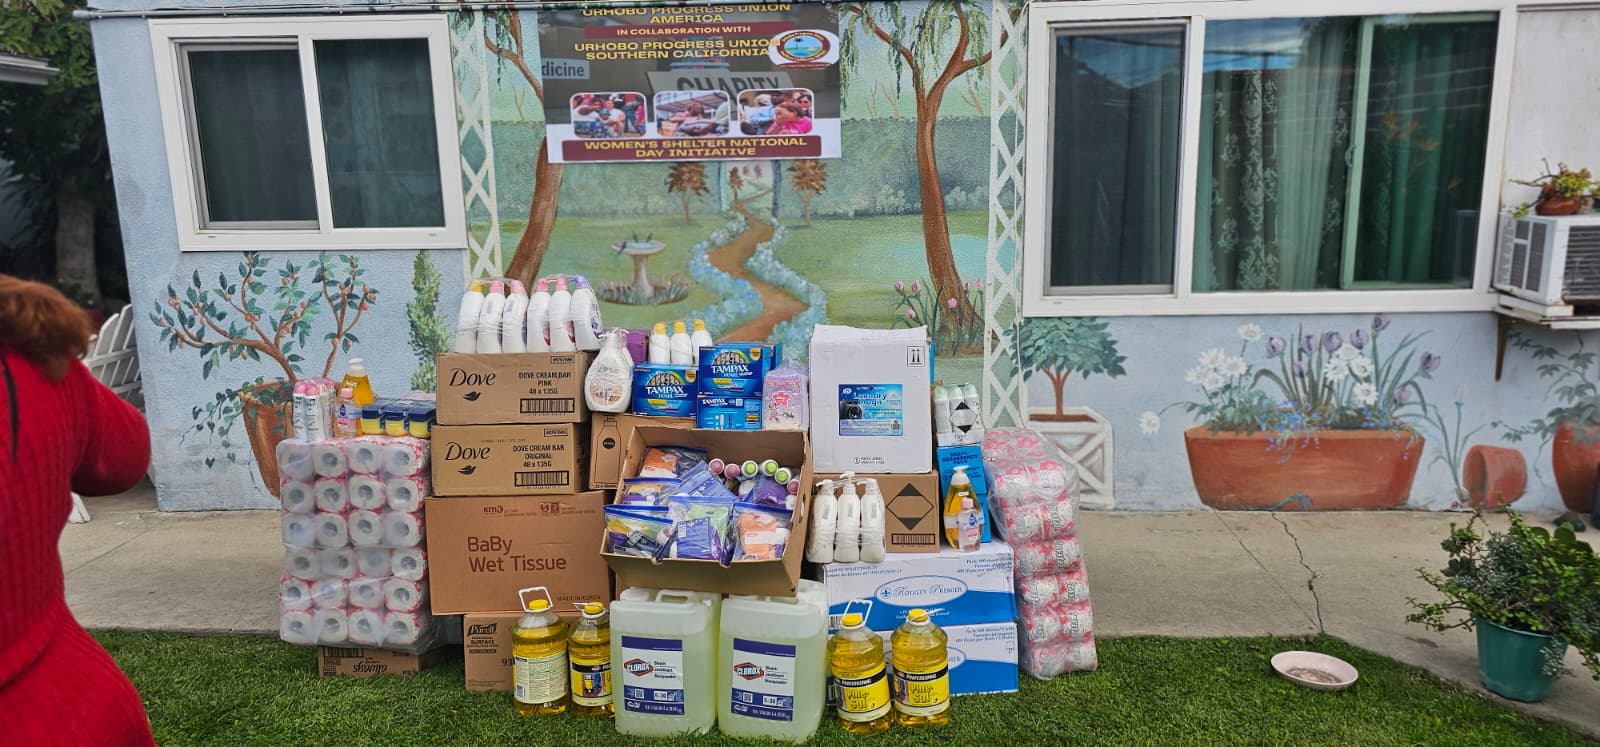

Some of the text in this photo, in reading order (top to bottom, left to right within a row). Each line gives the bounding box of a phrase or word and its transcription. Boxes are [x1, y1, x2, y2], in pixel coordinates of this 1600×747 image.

[651, 5, 734, 15] PROGRESS
[738, 4, 791, 13] UNION
[650, 14, 724, 24] AMERICA
[630, 27, 720, 36] COLLABORATION
[574, 38, 780, 51] URHOBO PROGRESS UNION
[586, 50, 669, 60] SOUTHERN
[672, 48, 769, 59] CALIFORNIA
[541, 61, 585, 77] dicine
[585, 137, 807, 150] WOMEN'S SHELTER NATIONAL
[635, 147, 757, 158] DAY INITIATIVE
[711, 365, 750, 373] TAMPAX
[449, 367, 496, 387] Dove
[645, 386, 685, 395] TAMPAX
[444, 441, 491, 461] Dove
[467, 536, 513, 556] BaBy
[469, 555, 567, 573] Wet Tissue
[626, 662, 651, 673] CLOROX
